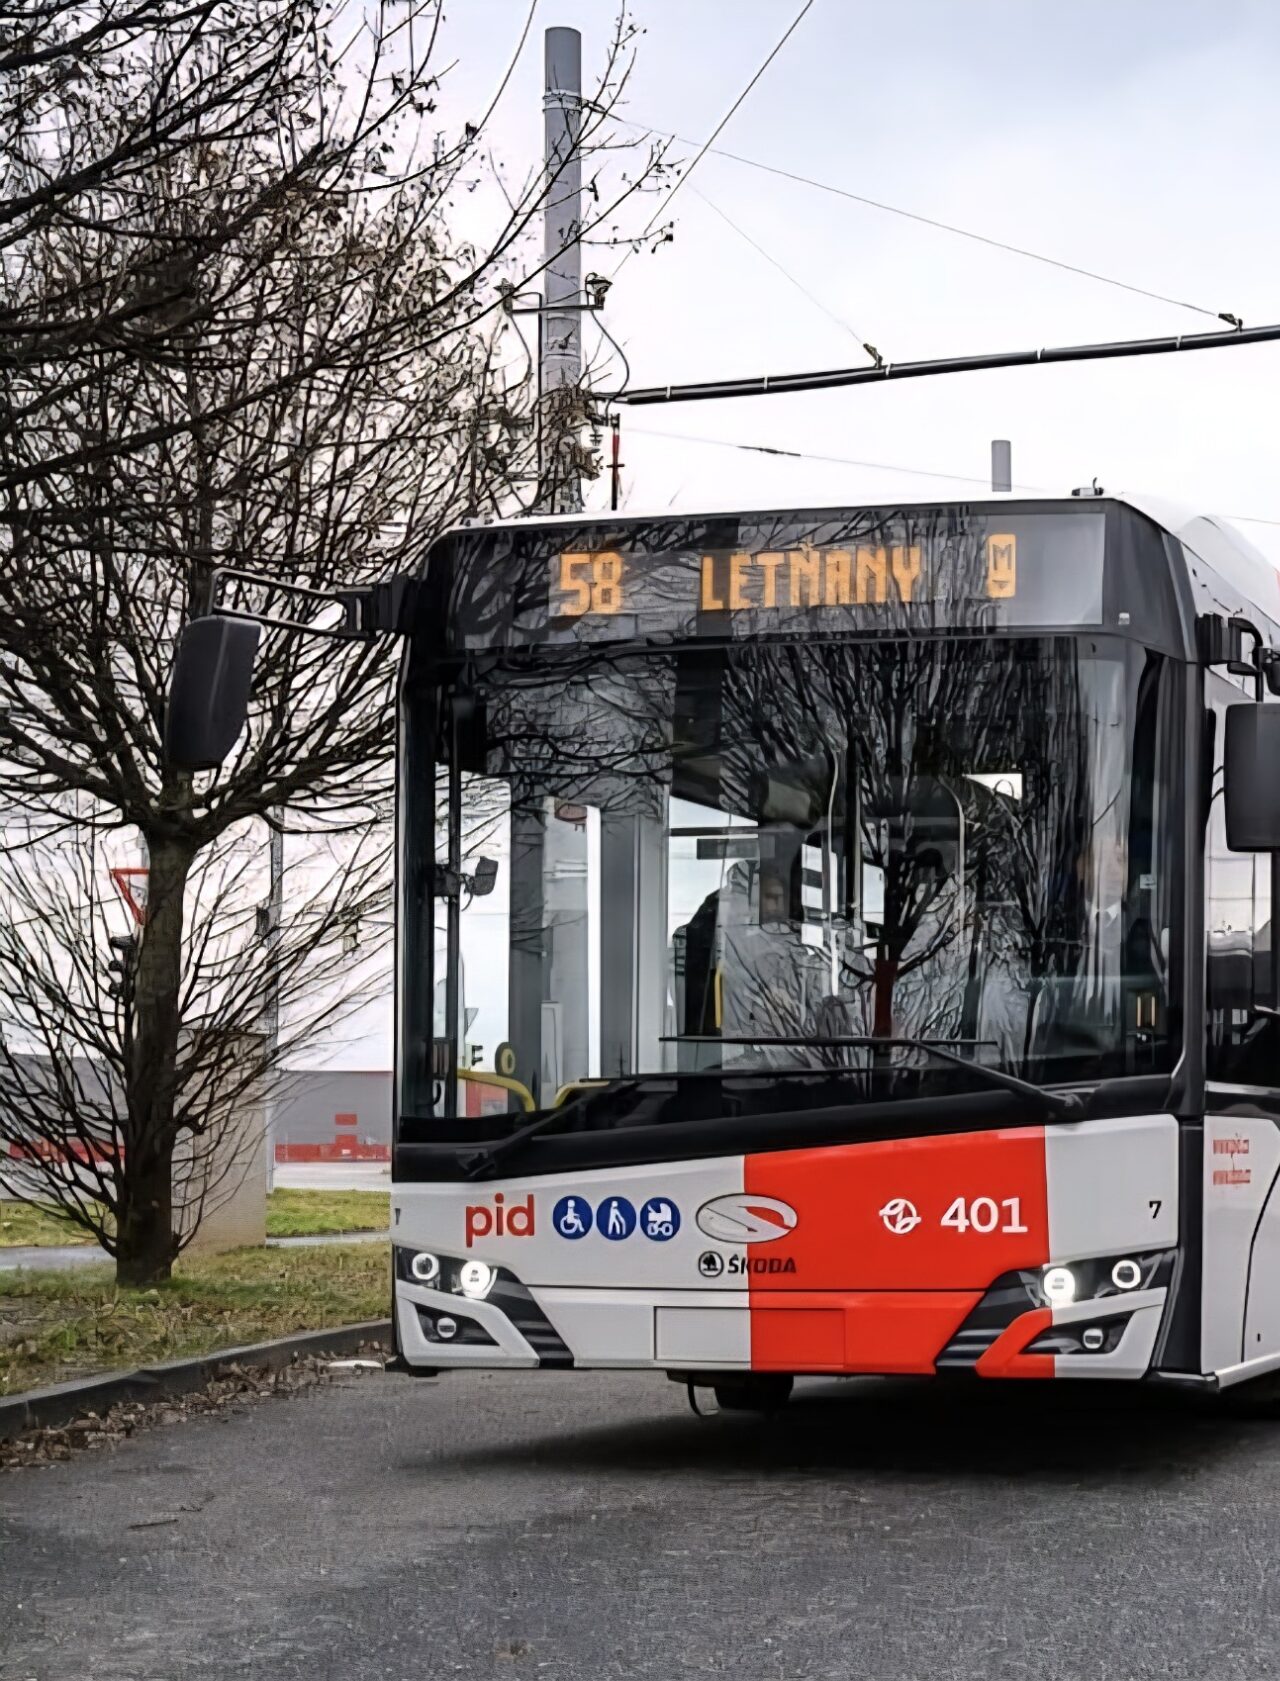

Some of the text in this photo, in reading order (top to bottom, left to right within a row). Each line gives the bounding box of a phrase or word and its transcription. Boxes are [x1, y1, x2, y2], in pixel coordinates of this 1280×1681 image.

[560, 552, 622, 615] 58
[465, 1192, 535, 1248] pid
[940, 1196, 1028, 1233] 401
[1149, 1200, 1162, 1219] 7
